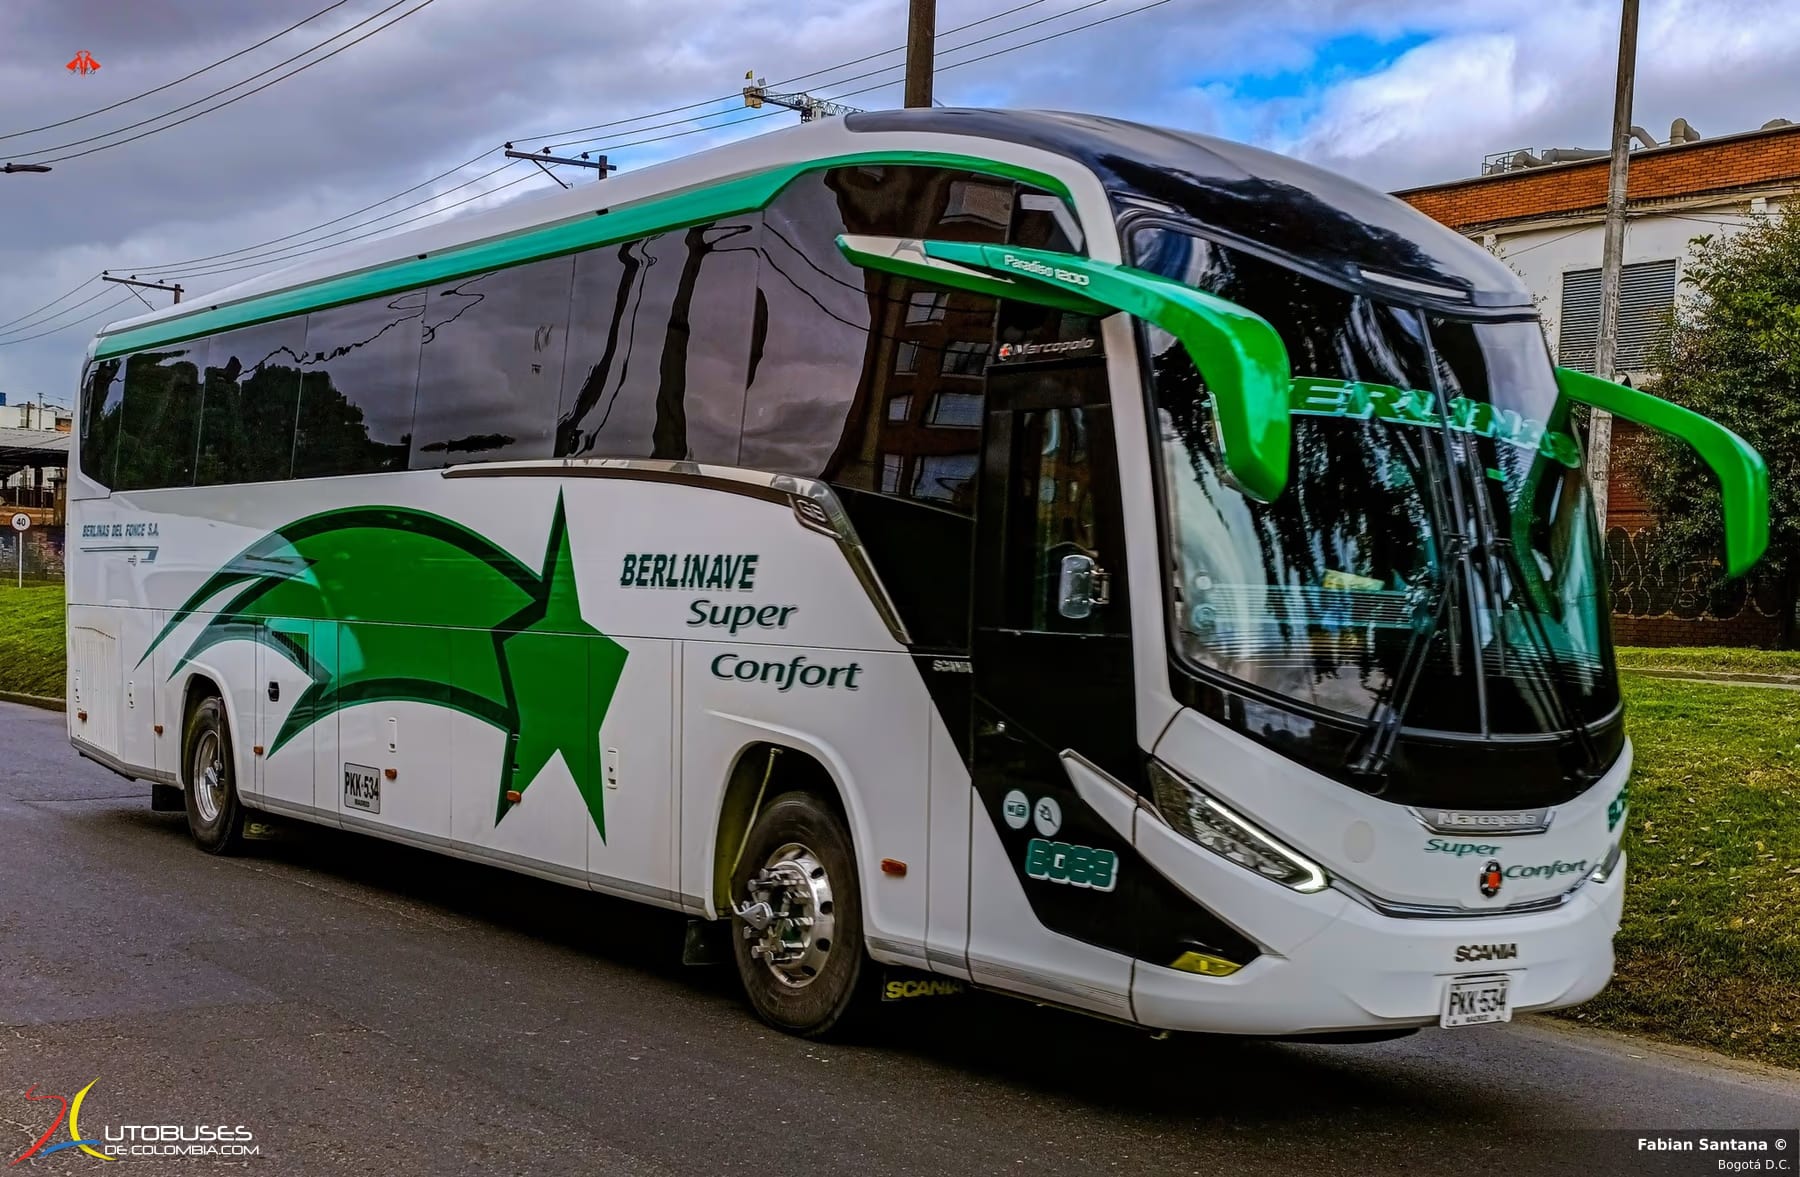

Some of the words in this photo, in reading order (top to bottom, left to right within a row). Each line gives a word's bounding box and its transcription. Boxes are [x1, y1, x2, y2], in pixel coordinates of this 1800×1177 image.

[1004, 254, 1054, 277] Paradiso
[1055, 268, 1090, 286] 1200
[1013, 338, 1095, 355] Marcopolo
[16, 517, 26, 527] 40
[82, 524, 110, 537] BERLINAS
[111, 524, 123, 537] DEL
[125, 523, 146, 536] FONCE
[620, 553, 759, 591] BERLINAVE
[686, 599, 798, 635] Super
[711, 653, 862, 692] Confort
[344, 771, 379, 801] PKK-534
[1424, 838, 1502, 856] Super
[1502, 859, 1587, 879] Confort
[1454, 943, 1518, 962] SCANIA
[1448, 987, 1507, 1016] PKK-534
